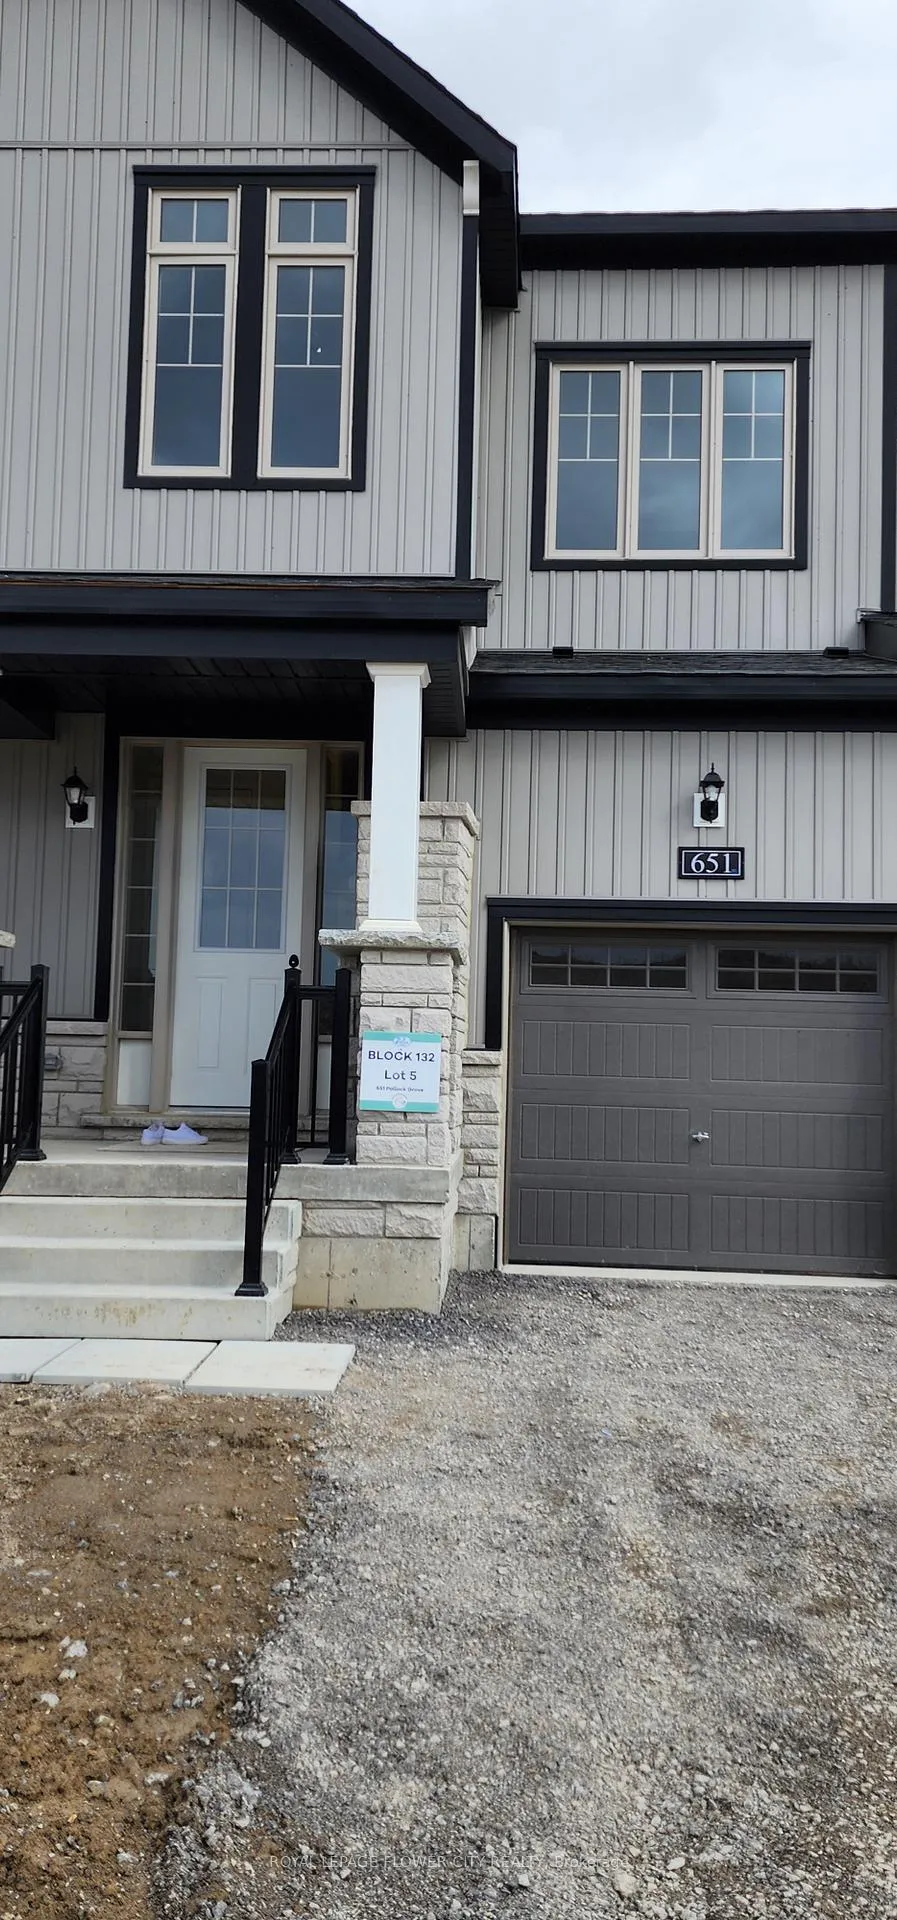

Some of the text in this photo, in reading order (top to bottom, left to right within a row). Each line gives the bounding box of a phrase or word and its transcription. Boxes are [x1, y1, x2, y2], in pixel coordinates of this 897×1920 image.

[691, 853, 731, 873] 651
[368, 1050, 435, 1062] BLOCK 132
[384, 1069, 417, 1081] Lot 5
